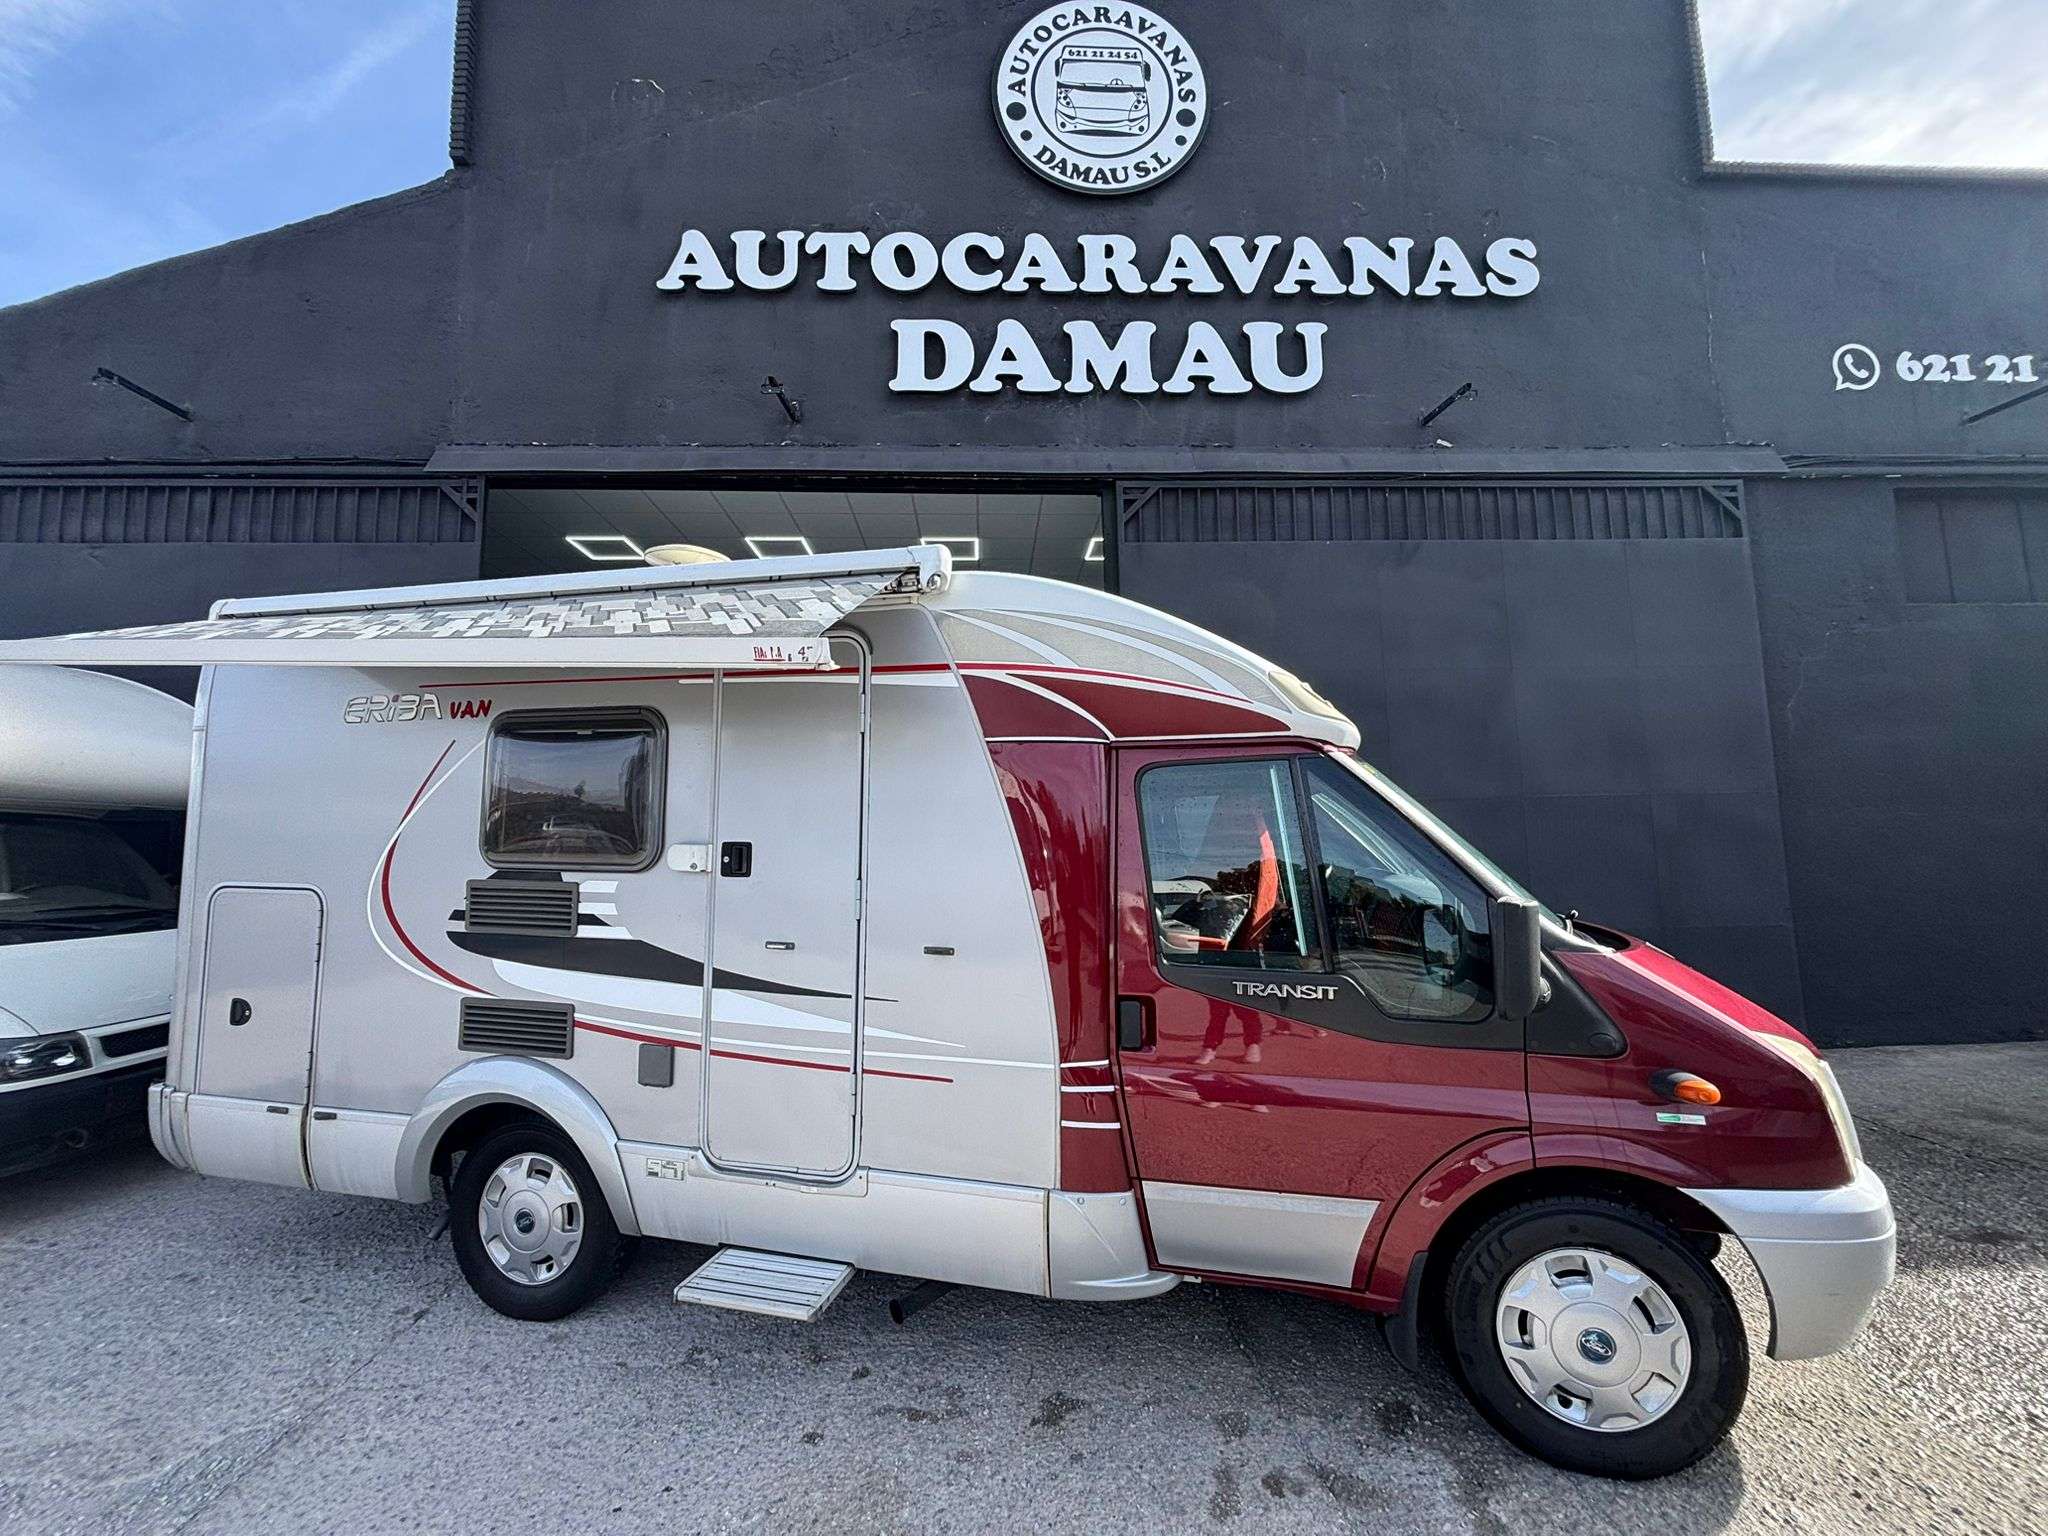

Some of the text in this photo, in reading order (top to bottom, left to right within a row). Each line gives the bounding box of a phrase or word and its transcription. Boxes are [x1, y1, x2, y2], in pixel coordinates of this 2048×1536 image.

[1008, 6, 1196, 103] AUTOCARAVANAS
[1068, 49, 1138, 59] 621 21 24 54
[1033, 145, 1129, 185] DAMAU
[656, 229, 1541, 298] AUTOCARAVANAS
[888, 318, 1329, 394] DAMAU
[1896, 351, 2039, 383] 621 21
[449, 699, 493, 720] VAN
[1232, 981, 1339, 1000] TRANSIT
